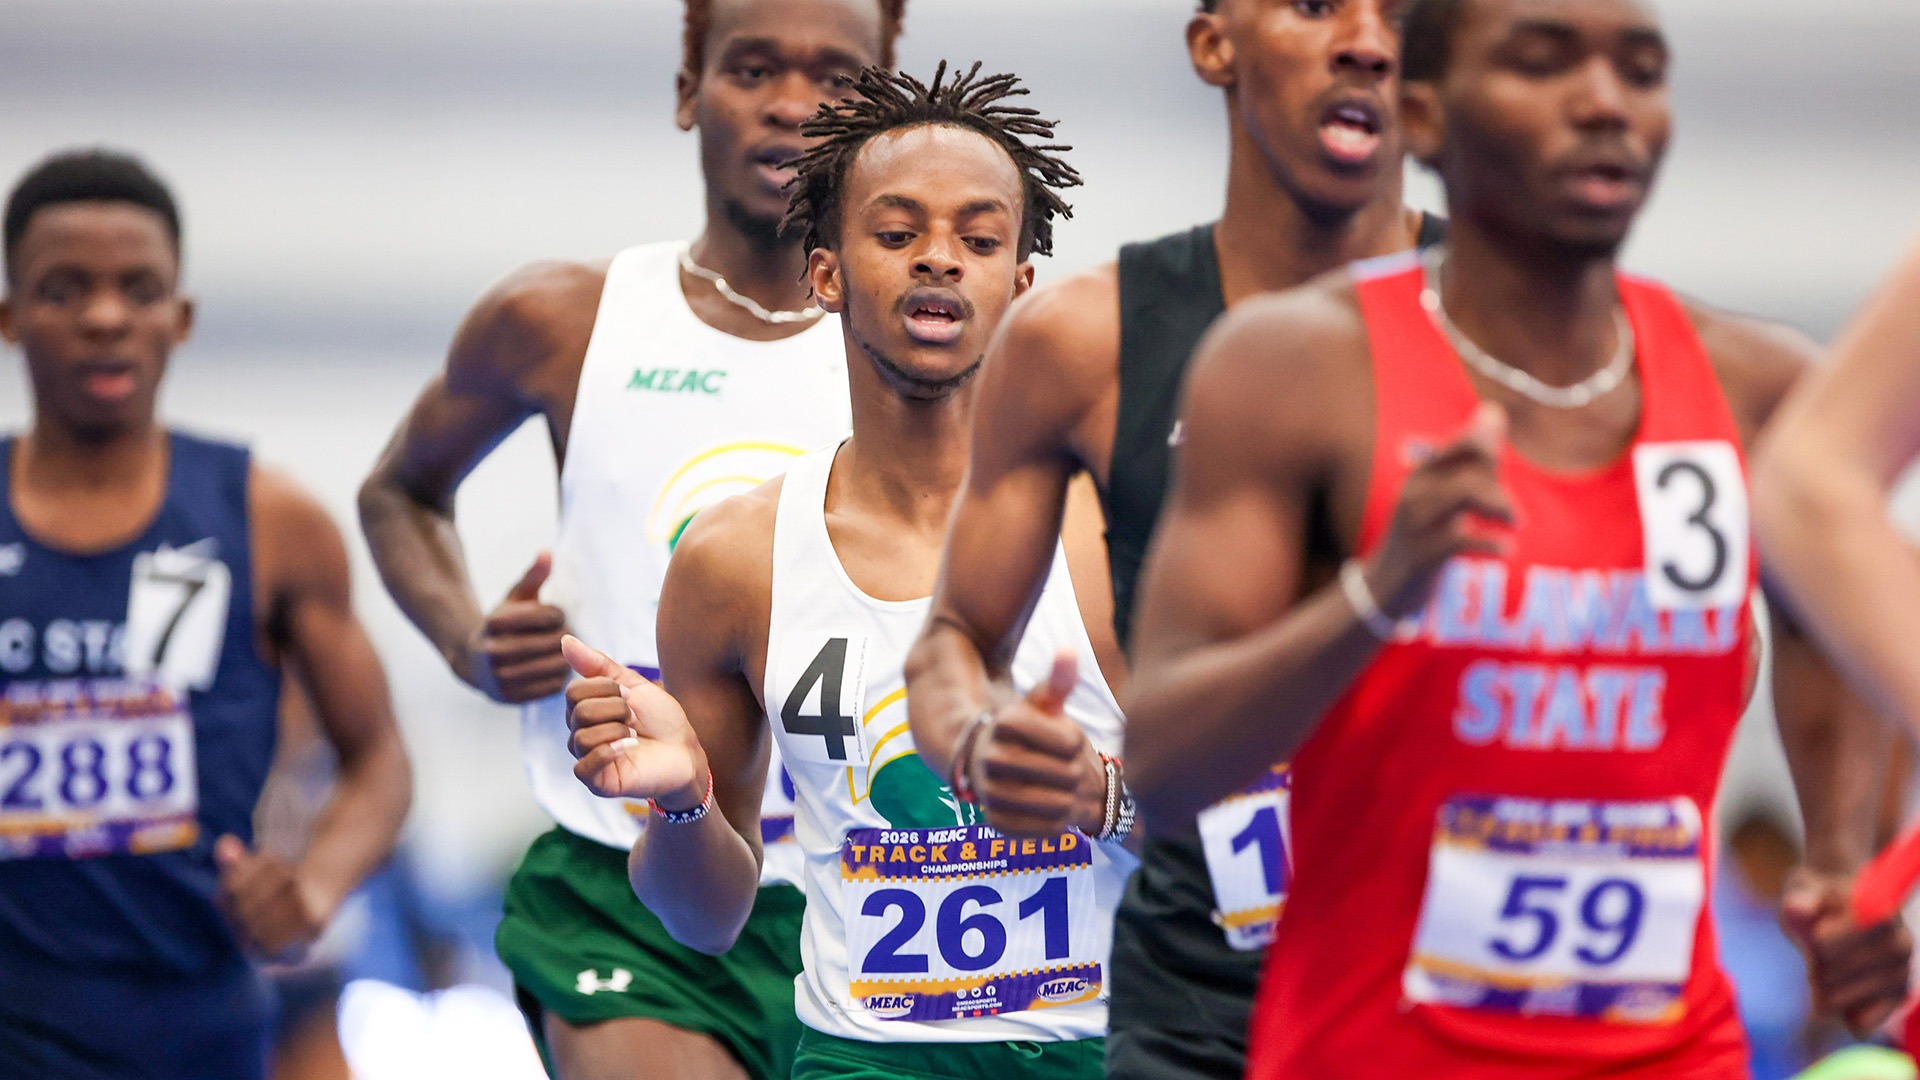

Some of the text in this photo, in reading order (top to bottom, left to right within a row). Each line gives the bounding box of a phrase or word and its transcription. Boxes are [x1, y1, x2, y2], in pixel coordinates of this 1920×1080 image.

[625, 368, 728, 395] MEAC
[1656, 460, 1727, 592] 3
[145, 572, 205, 670] 7
[780, 637, 855, 761] 4
[1453, 657, 1668, 753] STATE
[0, 736, 173, 810] 288
[851, 833, 1078, 863] TRACK & FIELD
[879, 831, 919, 844] 2026
[926, 827, 968, 845] MEAC
[920, 858, 1008, 874] CHAMPIONSHIPS
[860, 876, 1070, 974] 261
[1487, 875, 1647, 966] 59
[868, 996, 914, 1009] MEAC
[1042, 979, 1088, 996] MEAC
